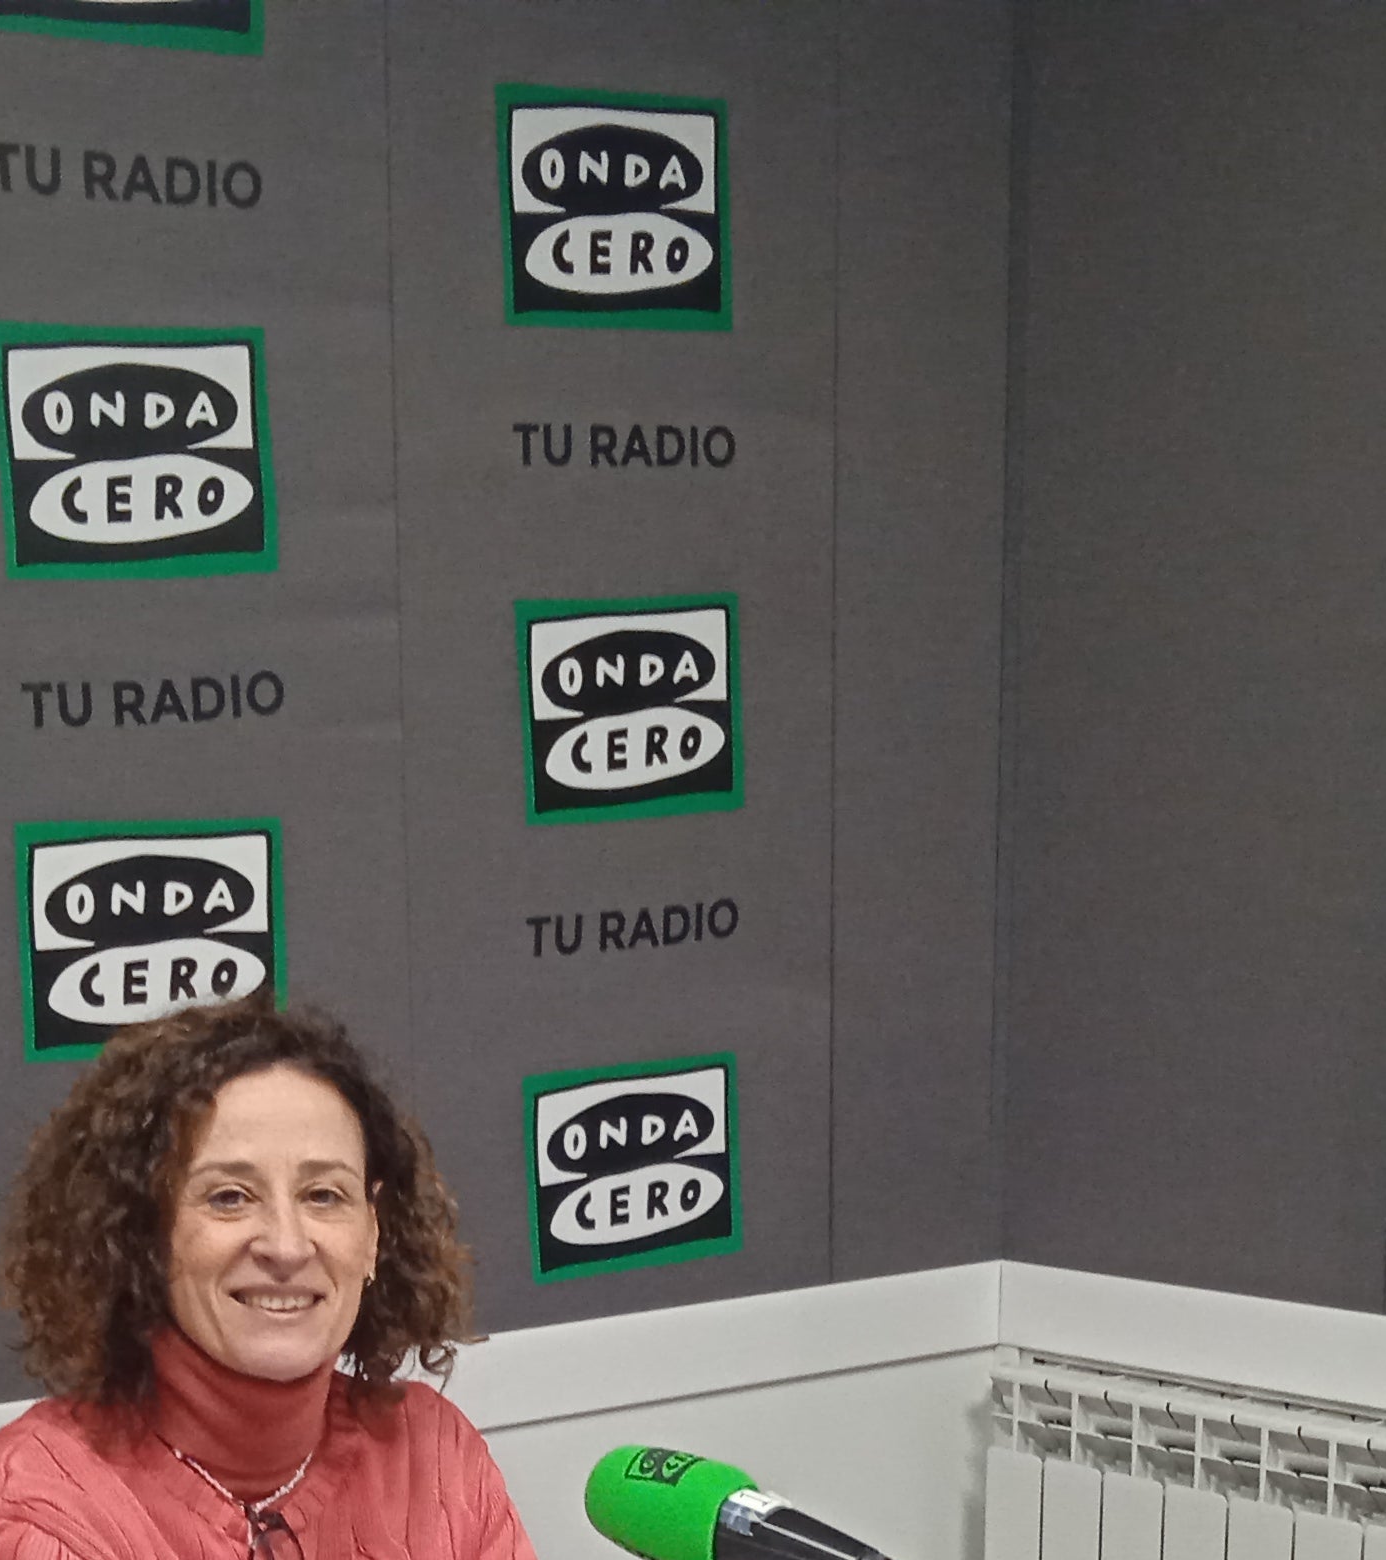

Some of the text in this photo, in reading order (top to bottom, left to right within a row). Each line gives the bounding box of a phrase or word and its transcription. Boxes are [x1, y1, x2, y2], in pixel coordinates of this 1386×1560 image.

[82, 150, 263, 209] RADIO
[539, 148, 686, 191] ONDA
[552, 229, 690, 275] CERO
[43, 390, 219, 435] ONDA
[513, 423, 736, 469] TU RADIO
[61, 475, 225, 524] CERO
[558, 650, 700, 696] ONDA
[21, 670, 285, 729] TU RADIO
[571, 724, 703, 774] CERO
[65, 879, 235, 925] ONDA
[526, 898, 740, 957] TU RADIO
[79, 957, 238, 1007] CERO
[563, 1108, 699, 1161] ONDA
[575, 1178, 703, 1232] CERO
